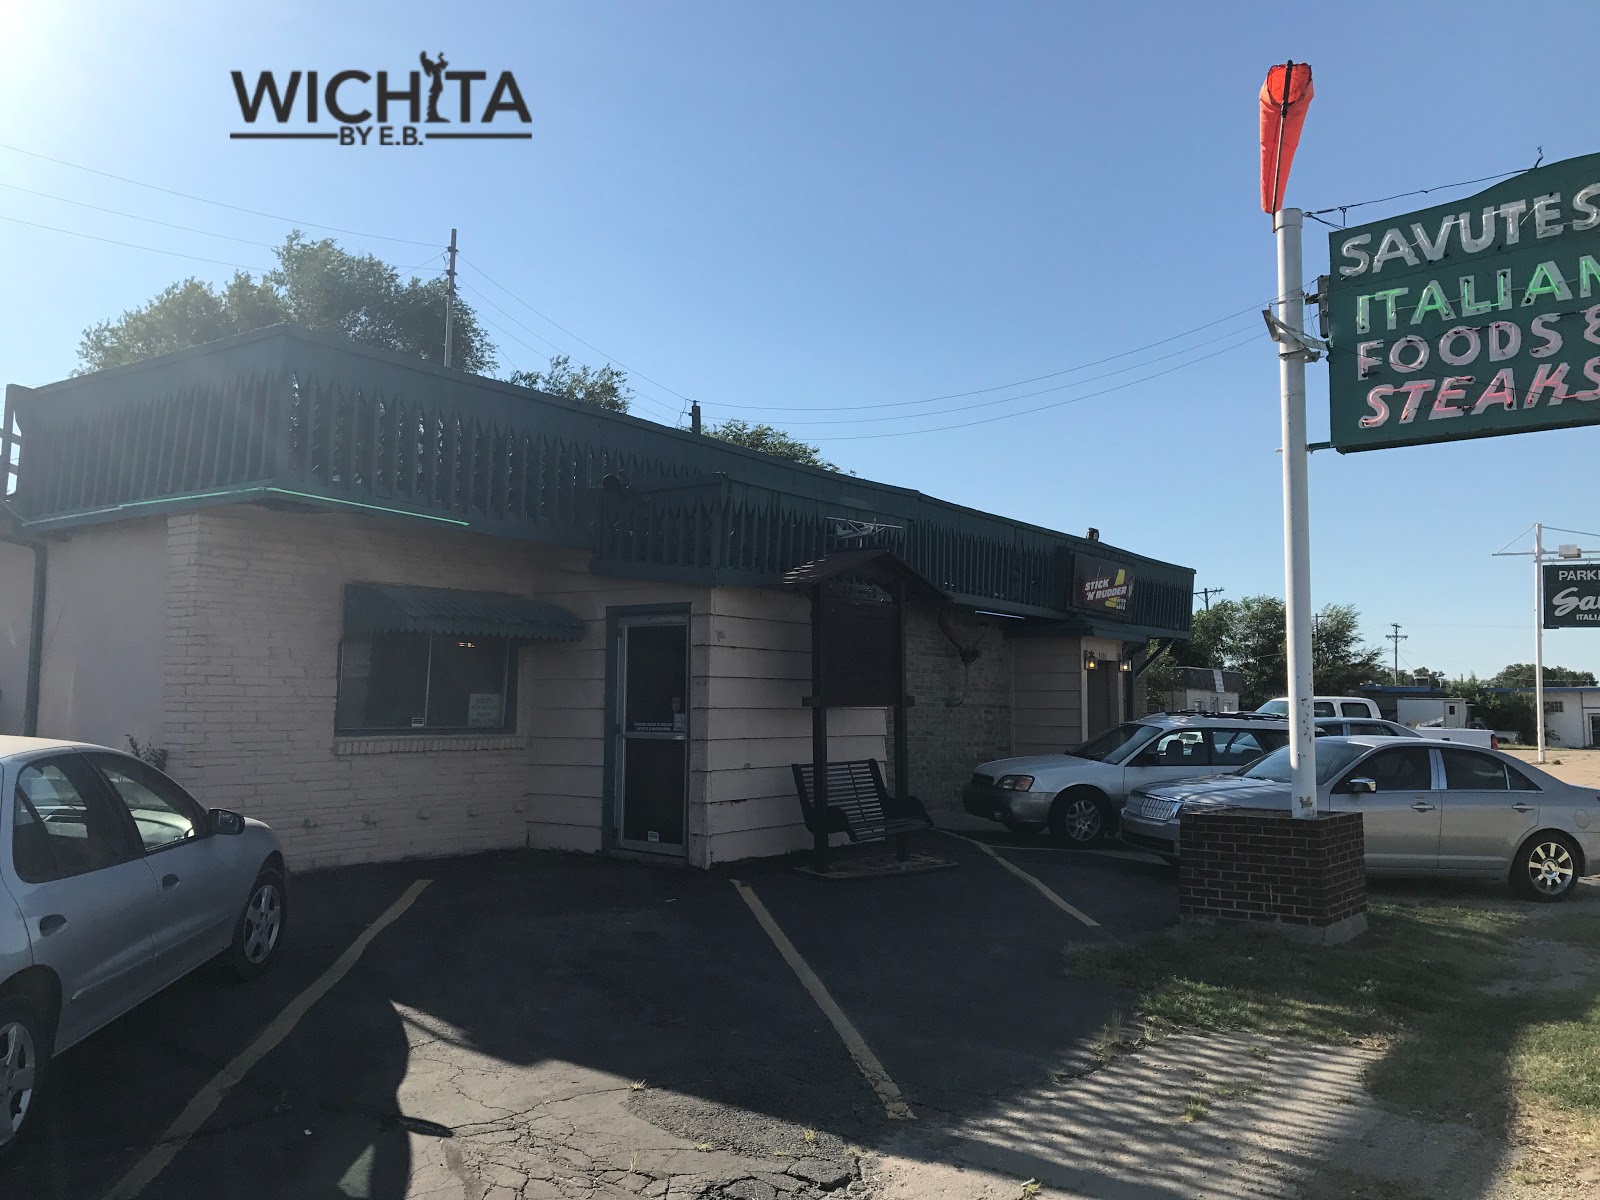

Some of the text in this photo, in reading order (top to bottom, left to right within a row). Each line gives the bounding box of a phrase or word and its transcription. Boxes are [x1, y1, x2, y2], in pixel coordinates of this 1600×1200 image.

[1357, 312, 1563, 380] FOODS
[1085, 579, 1109, 591] STICK
[1096, 586, 1127, 600] RUDDER
